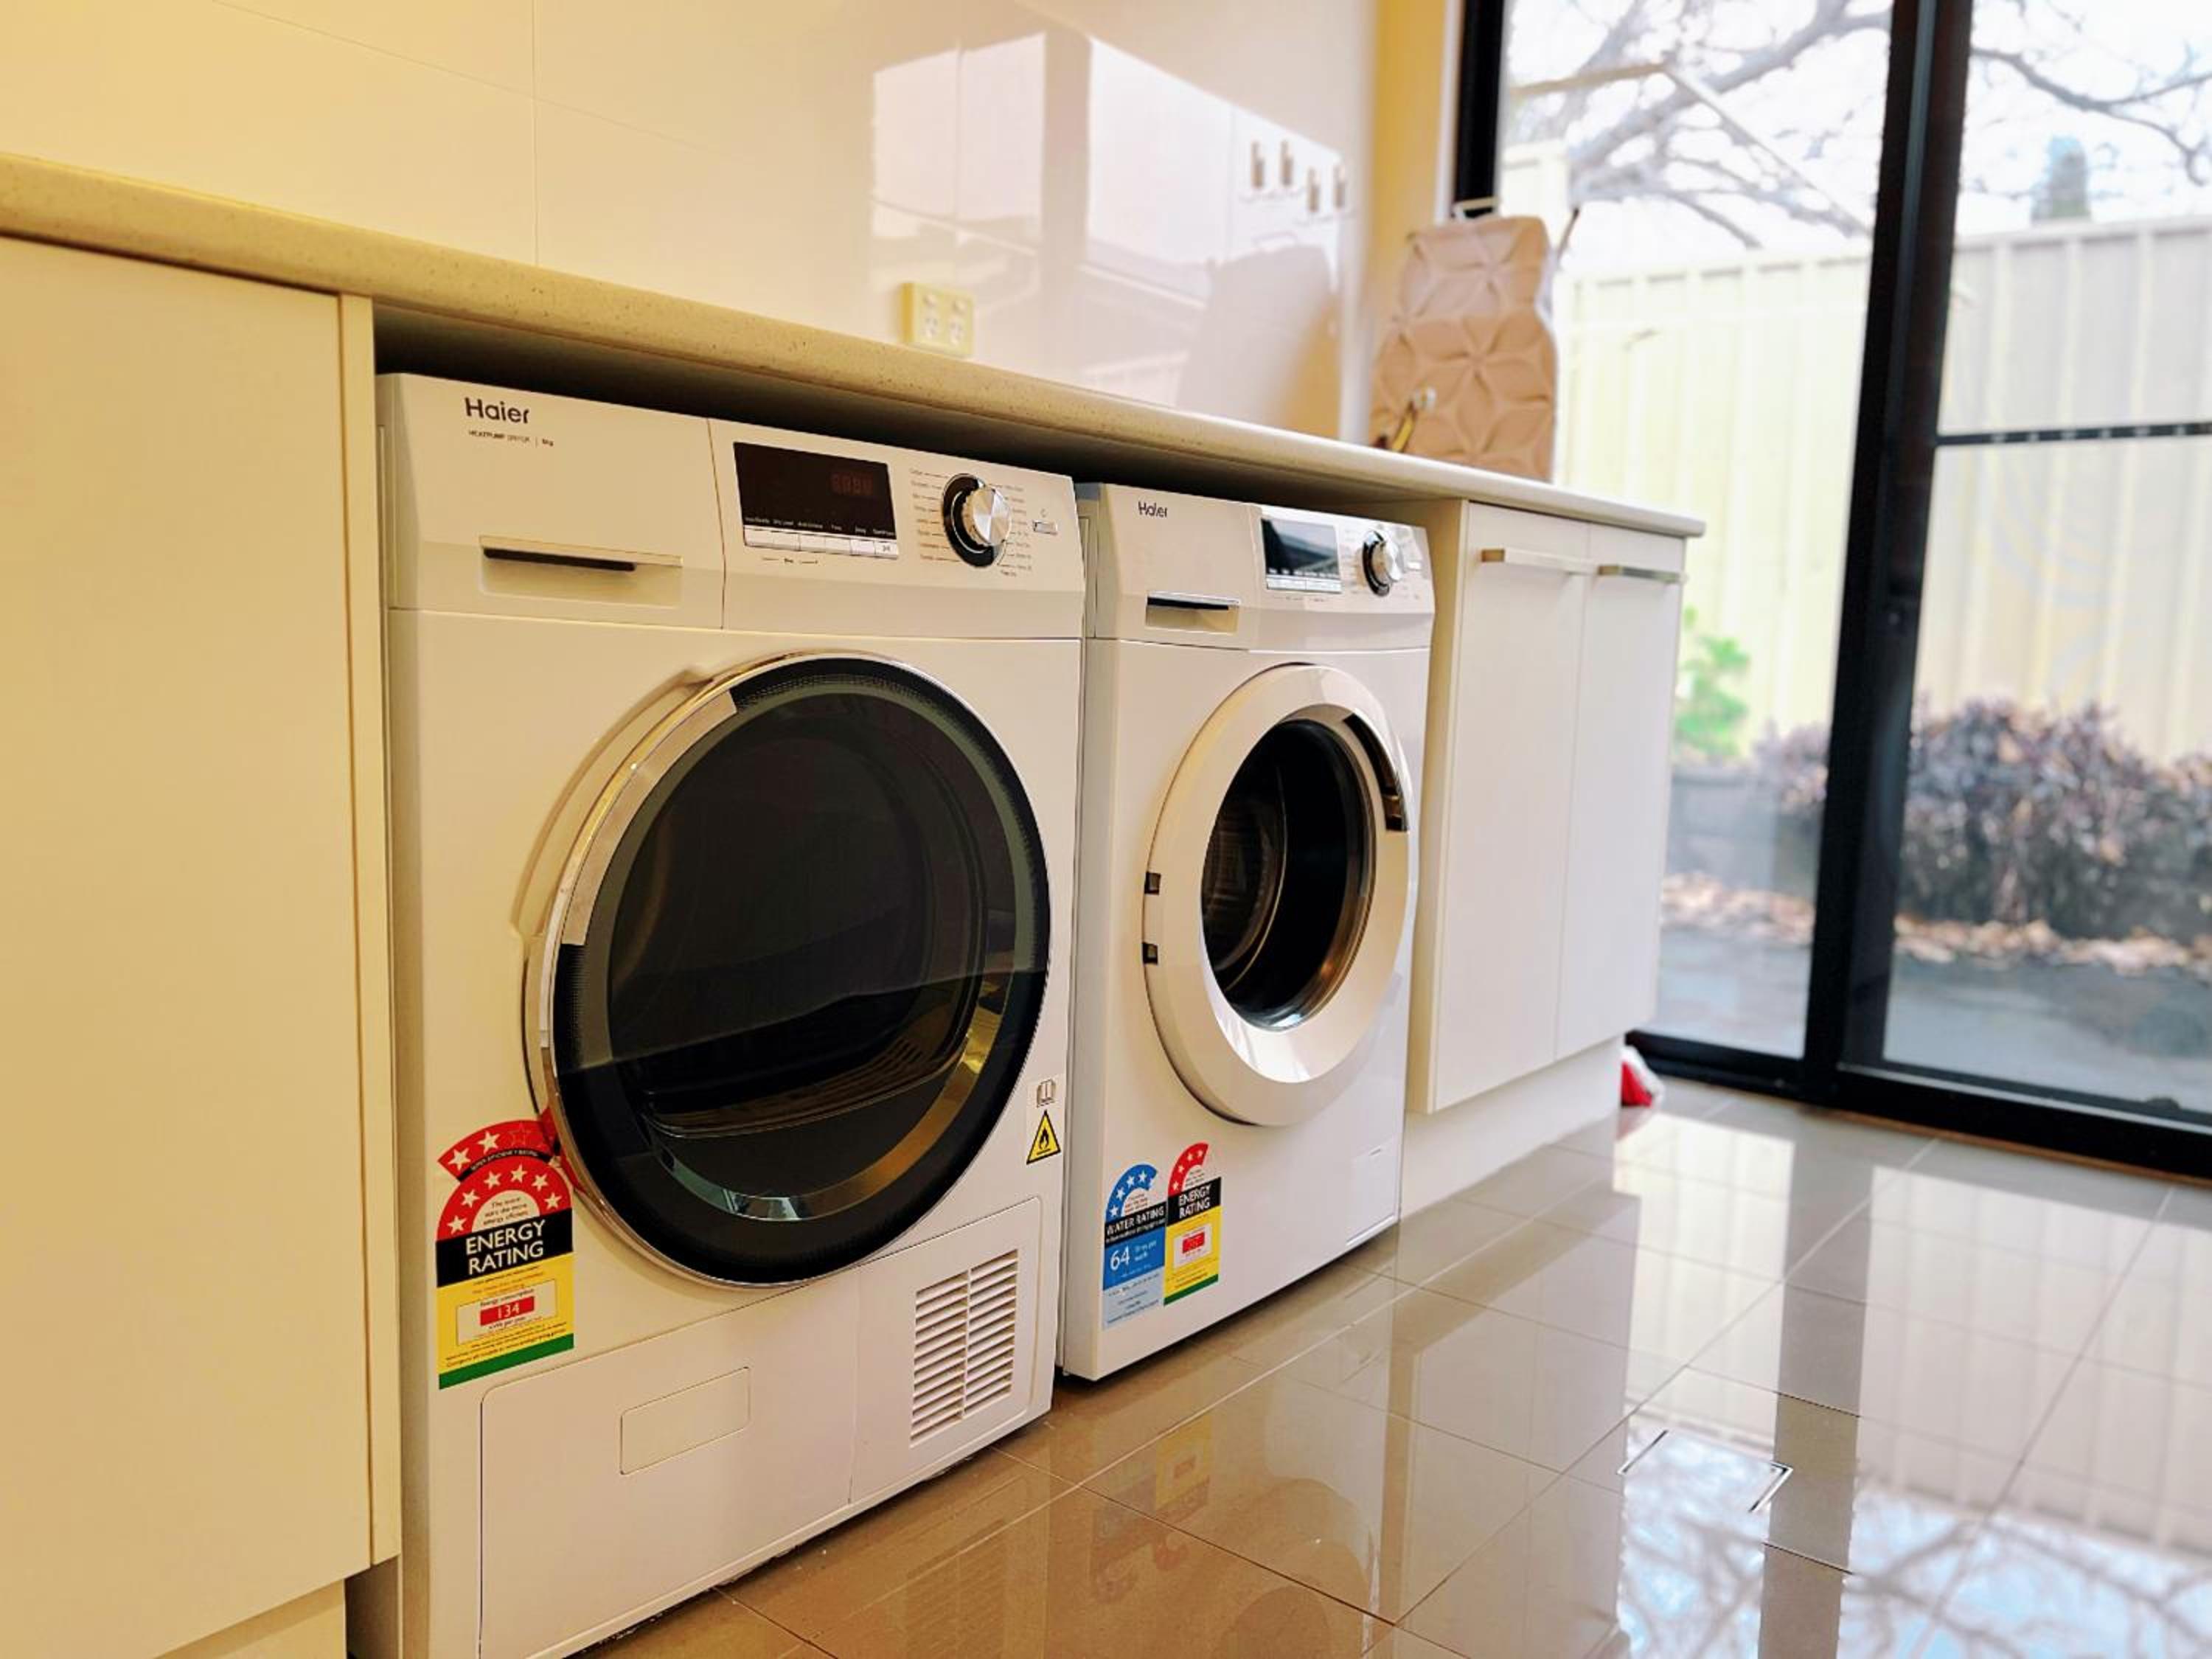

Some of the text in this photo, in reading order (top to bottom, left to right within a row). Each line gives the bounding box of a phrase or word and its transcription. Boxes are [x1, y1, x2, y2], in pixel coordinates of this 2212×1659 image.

[464, 397, 529, 424] Haier
[1138, 501, 1168, 518] Haier
[1178, 1184, 1211, 1208] ENERGY
[1179, 1197, 1211, 1219] RATING
[1107, 1217, 1135, 1236] WATER
[1135, 1206, 1164, 1224] RATING
[465, 1220, 546, 1255] ENERGY
[468, 1242, 544, 1276] RATING
[1110, 1245, 1130, 1270] 64
[497, 1303, 520, 1319] 134
